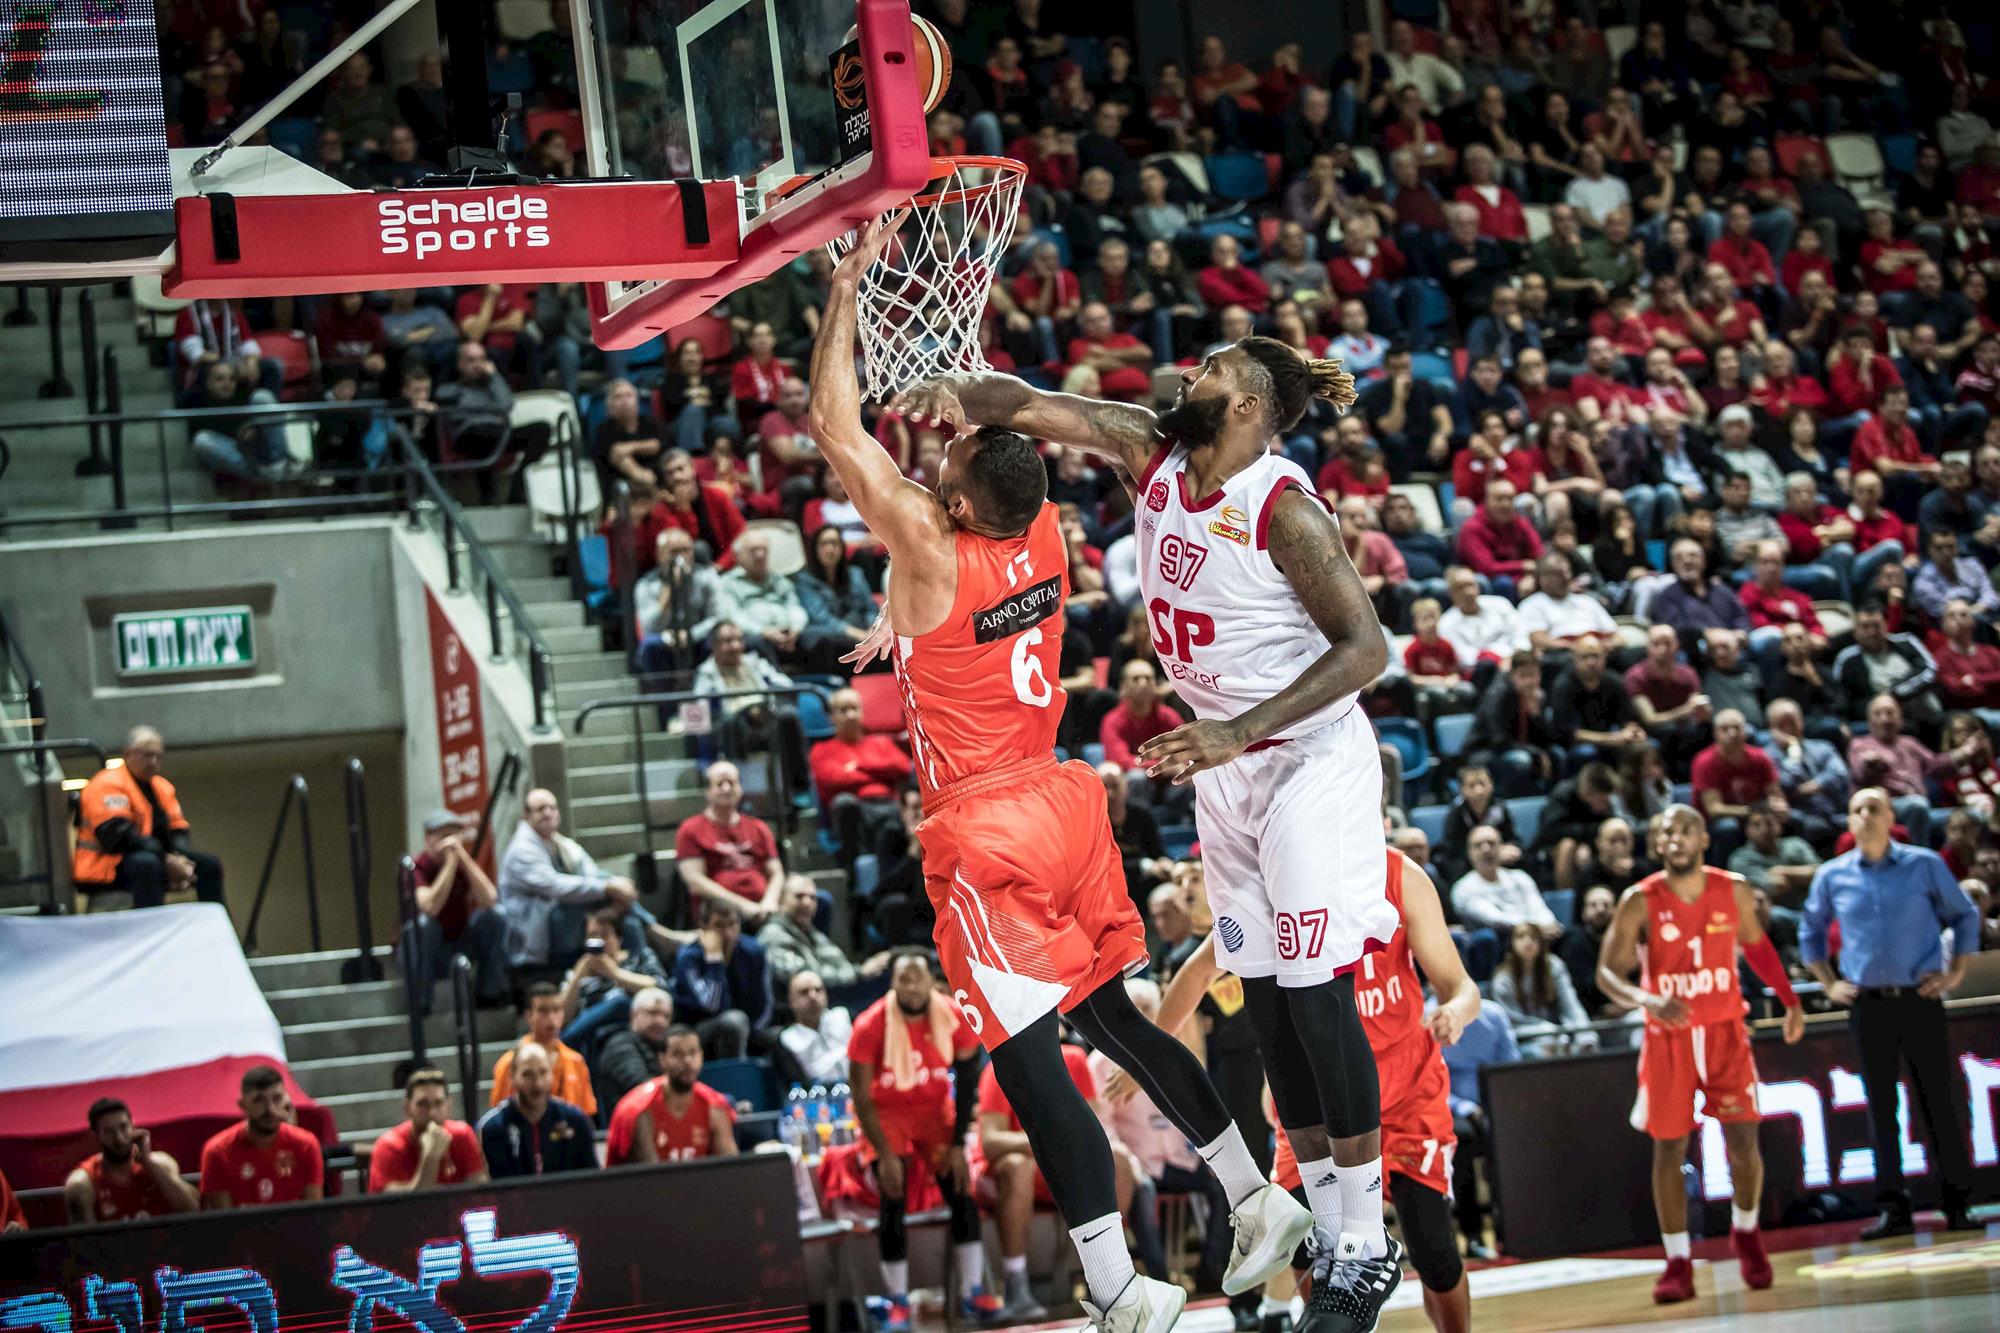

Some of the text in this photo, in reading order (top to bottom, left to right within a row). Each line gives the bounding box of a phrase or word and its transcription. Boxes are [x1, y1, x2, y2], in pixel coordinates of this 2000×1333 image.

[844, 108, 870, 134] נהלת
[378, 193, 549, 227] Schelde
[380, 221, 550, 260] Sports
[1160, 534, 1208, 592] 97
[980, 602, 1020, 630] ARNO
[1010, 626, 1053, 708] 6
[1276, 907, 1329, 960] 97
[1686, 935, 1703, 969] 1
[953, 988, 984, 1037] 6
